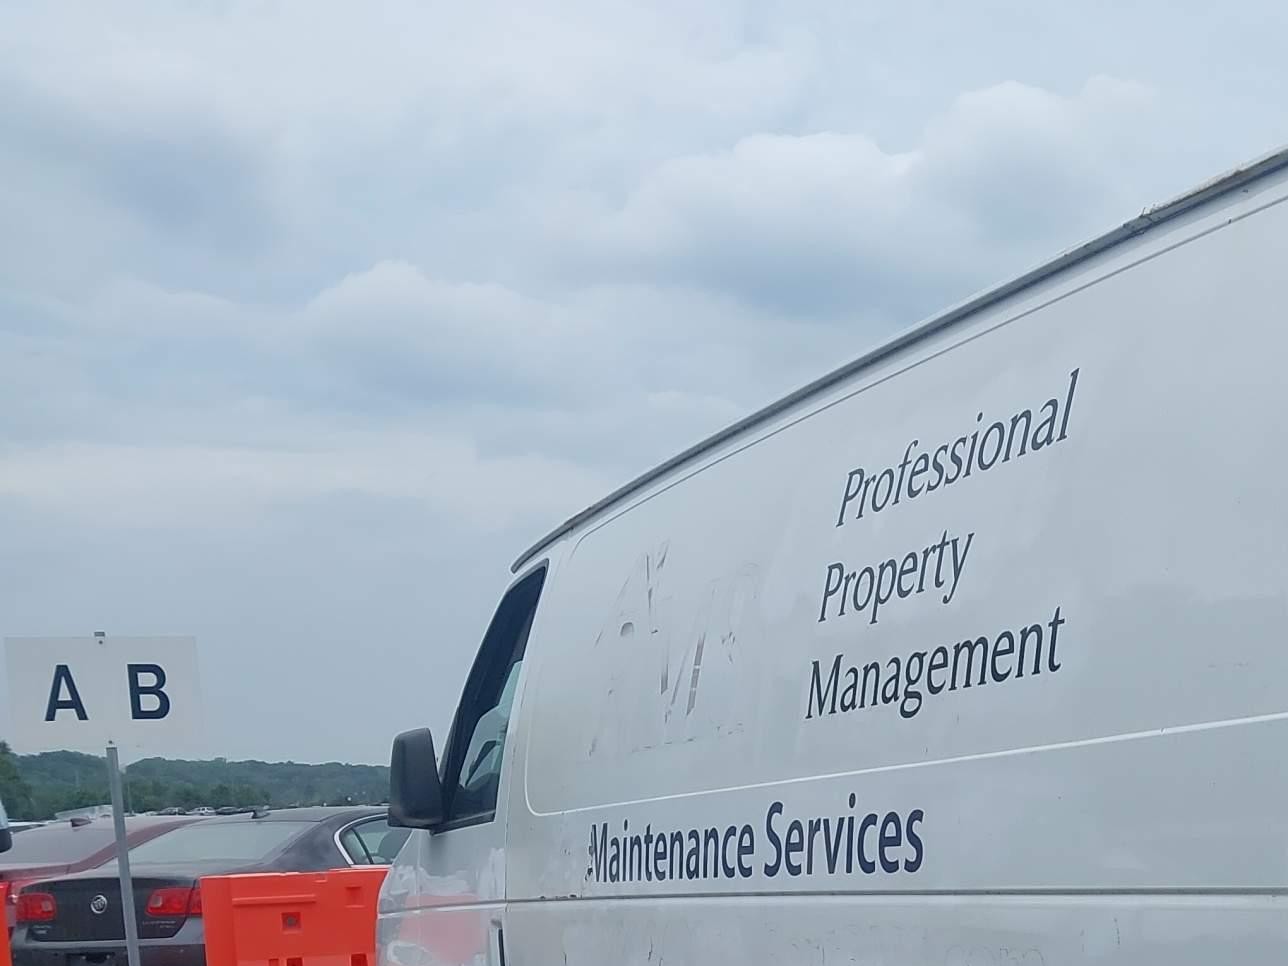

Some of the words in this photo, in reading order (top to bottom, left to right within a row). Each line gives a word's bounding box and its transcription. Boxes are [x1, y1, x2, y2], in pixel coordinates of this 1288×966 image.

[837, 368, 1080, 528] Professional
[818, 529, 975, 624] Property
[44, 664, 89, 722] A
[127, 663, 171, 720] B
[805, 606, 1066, 719] Management
[589, 818, 754, 883] Maintenance
[763, 792, 924, 878] Services
